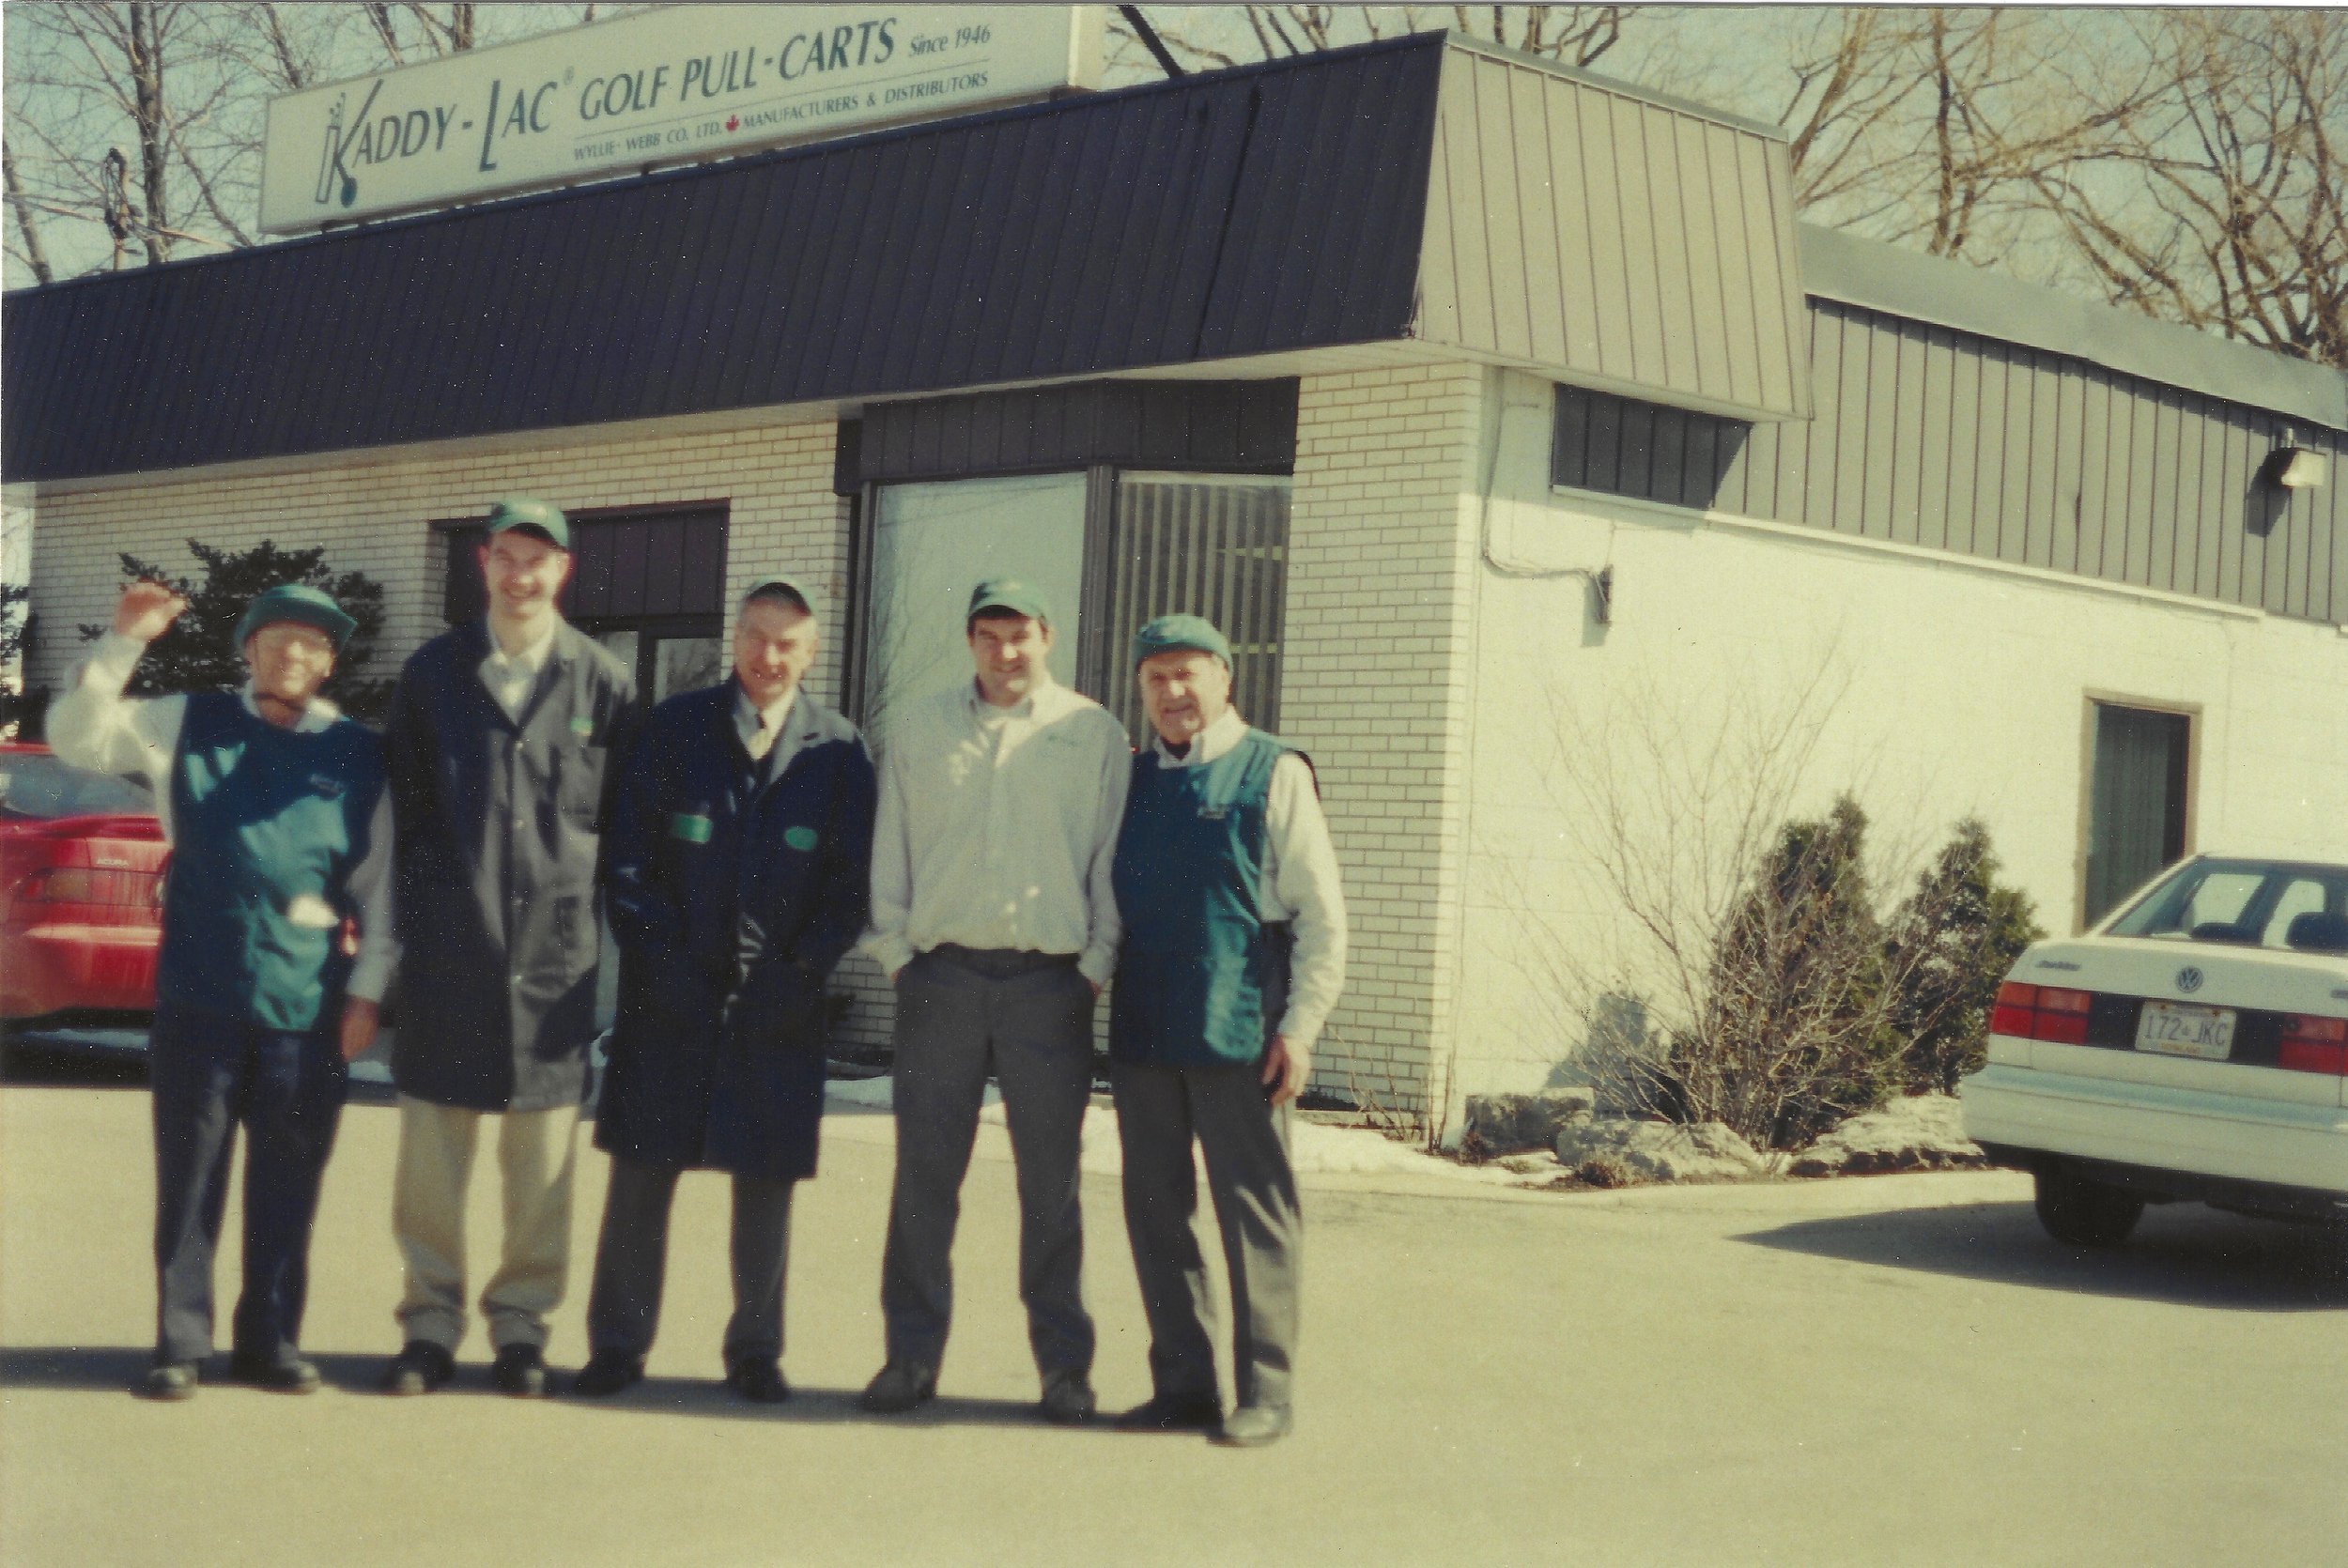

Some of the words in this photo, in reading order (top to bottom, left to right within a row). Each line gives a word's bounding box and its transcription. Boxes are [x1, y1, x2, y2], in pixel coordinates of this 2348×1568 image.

[579, 65, 669, 120] GOLF
[909, 33, 949, 57] Since
[954, 23, 992, 50] 1946
[743, 95, 858, 129] MANUFACTURERS
[866, 91, 877, 108] &
[885, 71, 988, 104] DISTRIBUTORS
